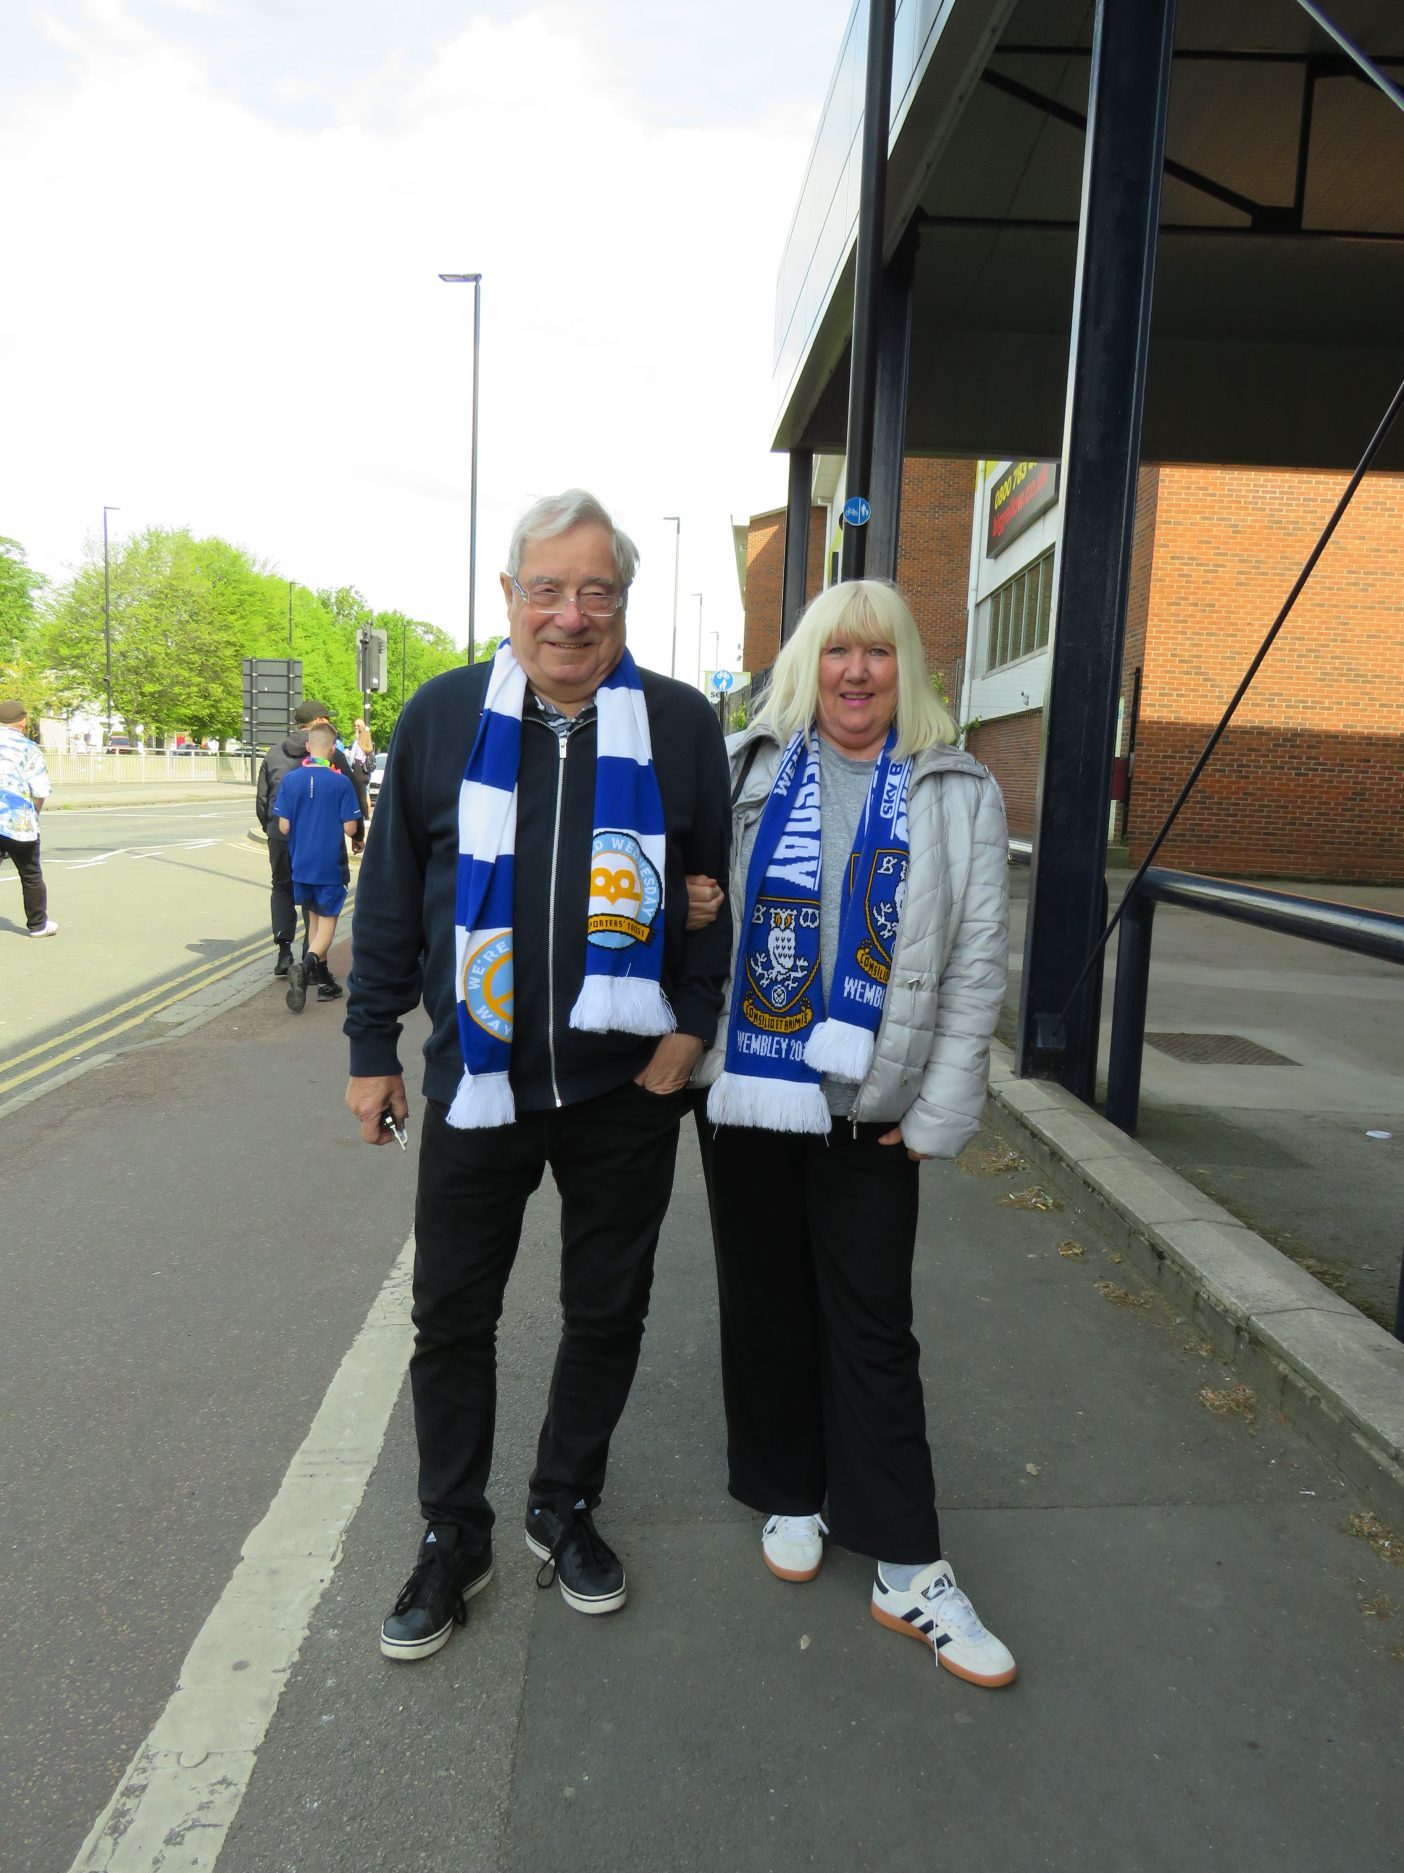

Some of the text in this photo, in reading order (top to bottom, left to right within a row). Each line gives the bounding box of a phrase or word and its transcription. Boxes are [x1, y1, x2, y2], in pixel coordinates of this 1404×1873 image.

[994, 476, 1012, 510] 0800
[467, 940, 511, 991] WE'RE
[737, 1029, 789, 1059] WEMBLEY
